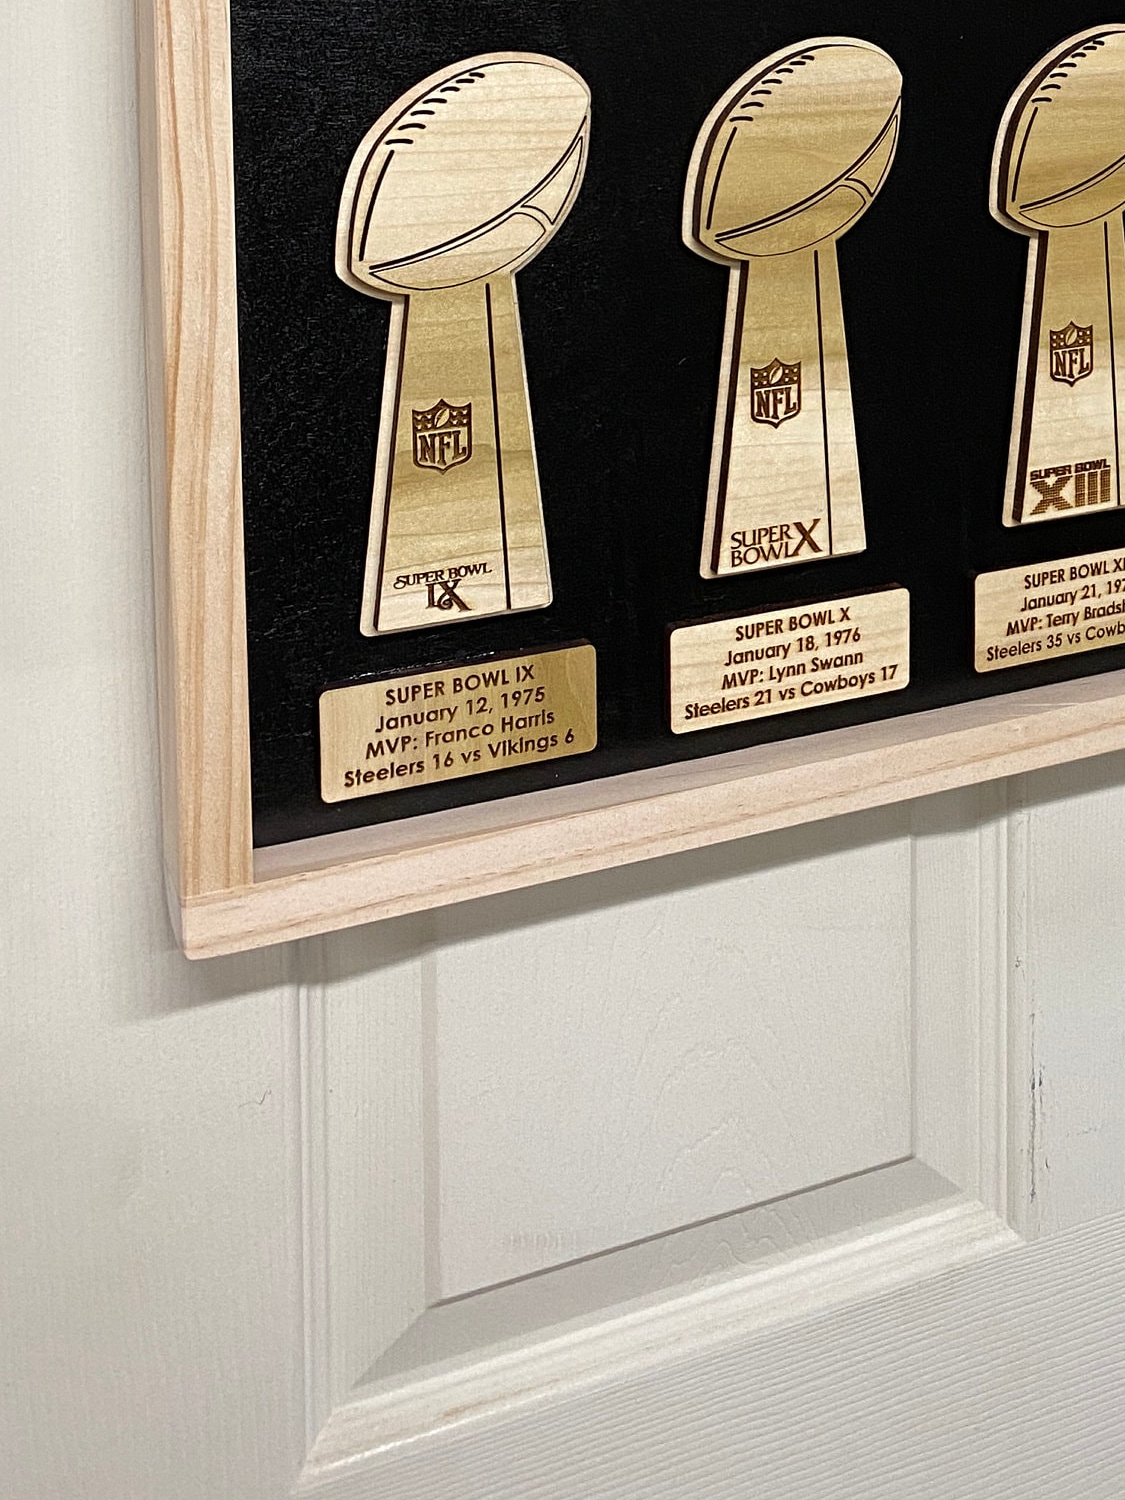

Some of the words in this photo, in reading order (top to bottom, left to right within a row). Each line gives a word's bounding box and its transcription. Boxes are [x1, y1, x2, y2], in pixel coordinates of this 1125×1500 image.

[1054, 348, 1089, 379] NFL
[755, 386, 797, 419] NFL
[418, 430, 466, 466] NFL
[1030, 465, 1073, 481] SUPER
[1075, 459, 1110, 473] BOWL
[1030, 468, 1111, 516] XIII
[731, 524, 793, 549] SUPER
[788, 518, 823, 556] X
[731, 542, 796, 567] BOWL
[393, 570, 445, 590] SUPER
[449, 563, 492, 581] BOWL
[1024, 569, 1065, 589] SUPER
[1070, 561, 1110, 581] BOWL
[425, 578, 472, 612] IX
[1020, 589, 1078, 612] January
[1081, 584, 1101, 599] 21,
[736, 619, 783, 641] SUPER
[789, 609, 835, 632] BOWL
[840, 606, 850, 621] X
[1006, 617, 1042, 637] MVP:
[1047, 610, 1080, 629] Terry
[724, 643, 791, 667] January
[797, 635, 819, 652] 18,
[825, 627, 861, 647] 1976
[987, 640, 1041, 661] Steelers
[1047, 634, 1062, 649] 35
[1067, 632, 1080, 645] vs
[386, 681, 445, 706] SUPER
[453, 669, 509, 694] BOWL
[516, 664, 534, 682] IX
[722, 669, 764, 690] MVP:
[769, 663, 805, 683] Lynn
[811, 651, 863, 672] Swann
[376, 706, 458, 733] January
[466, 697, 493, 716] 12,
[501, 686, 545, 708] 1975
[685, 697, 749, 720] Steelers
[754, 690, 772, 706] 21
[779, 689, 795, 701] vs
[801, 671, 875, 696] Cowboys
[881, 665, 898, 681] 17
[366, 737, 418, 760] MVP:
[426, 723, 494, 747] Franco
[502, 710, 554, 732] Harris
[344, 760, 424, 788] Steelers
[433, 752, 453, 770] 16
[461, 750, 480, 762] vs
[488, 733, 558, 758] Vikings
[566, 728, 574, 744] 6
